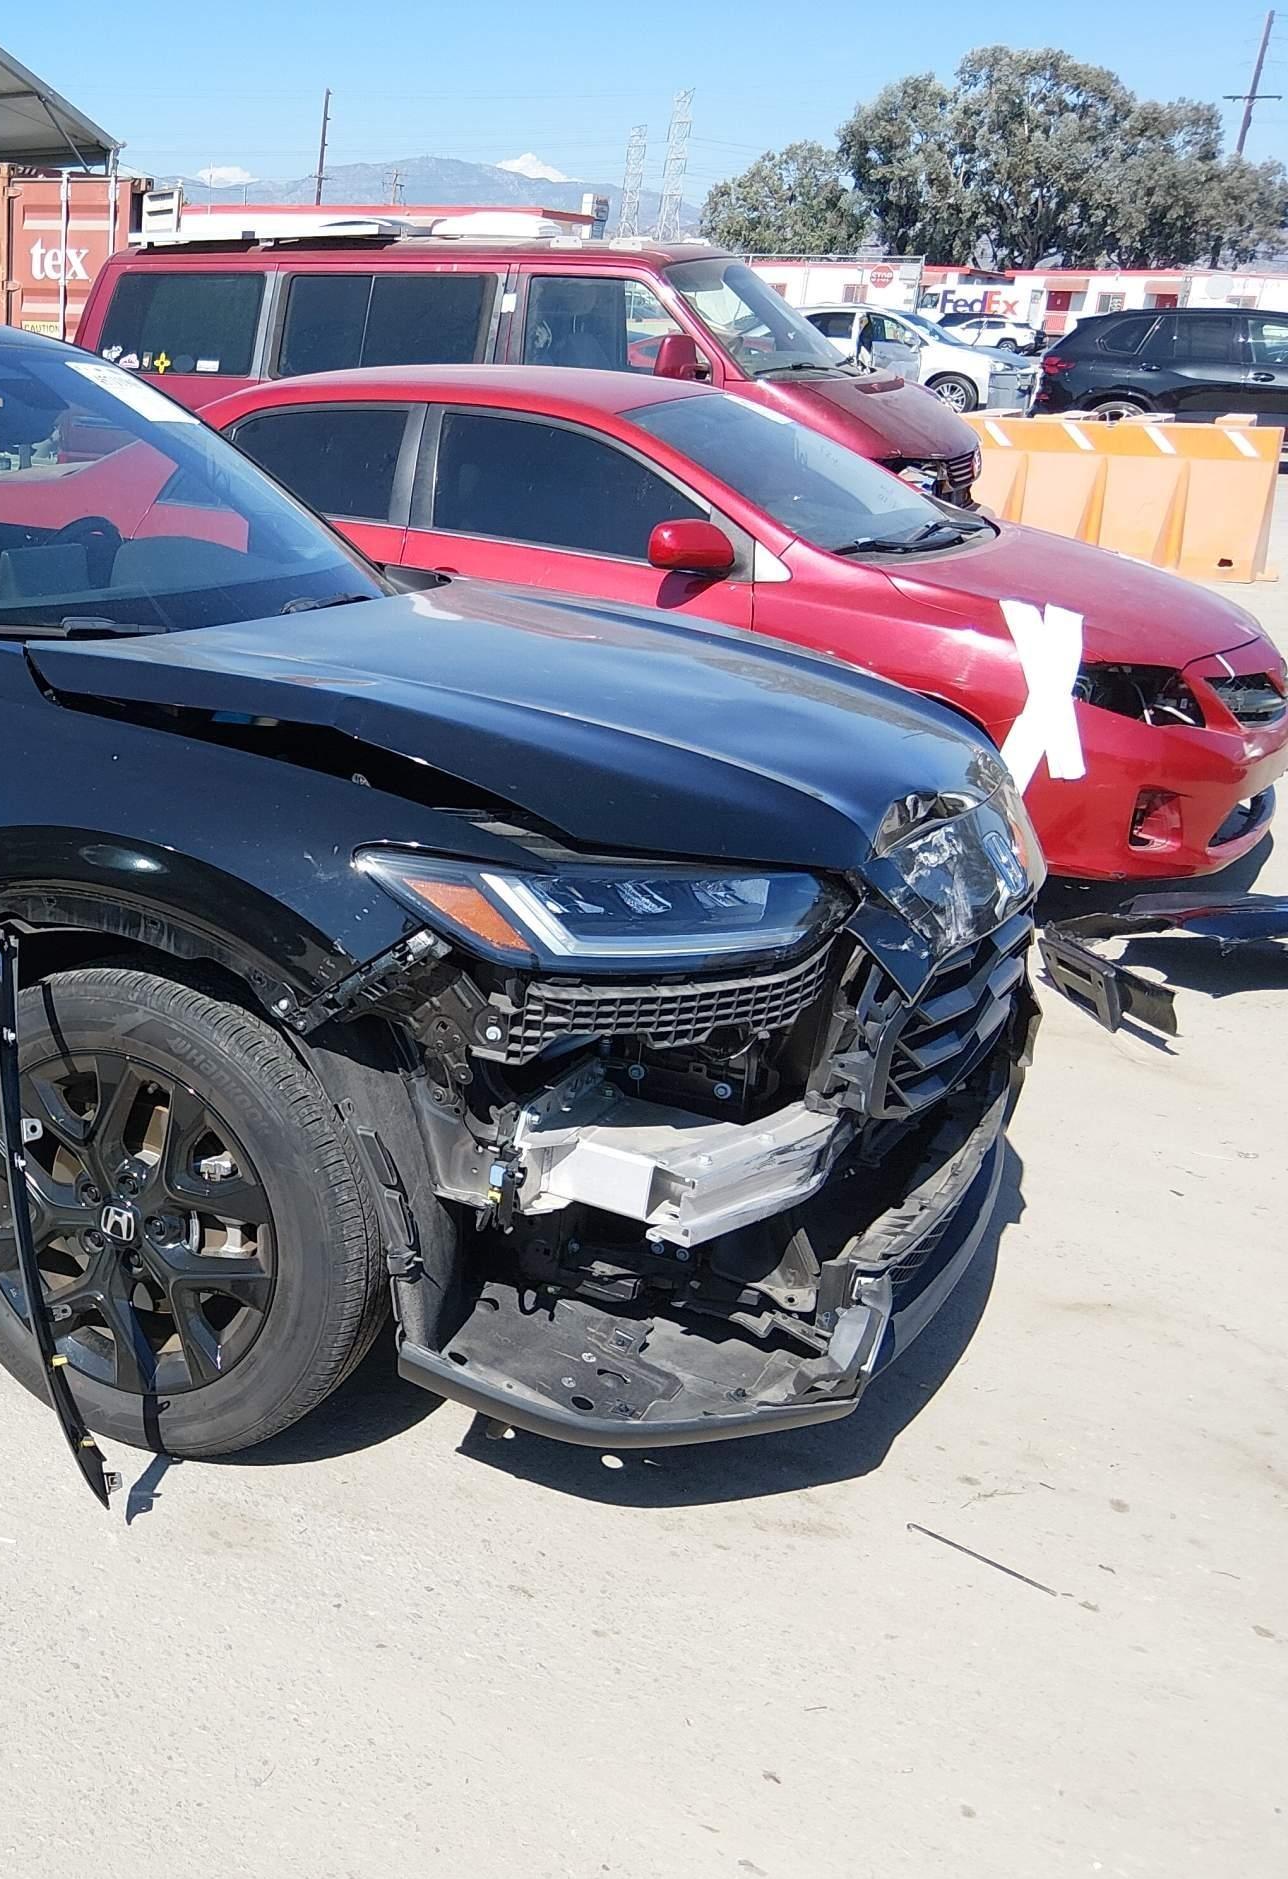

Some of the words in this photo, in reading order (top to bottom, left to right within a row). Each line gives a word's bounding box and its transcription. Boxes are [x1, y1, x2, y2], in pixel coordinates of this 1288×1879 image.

[870, 271, 893, 282] STOP
[940, 289, 1019, 315] FedEx
[24, 324, 60, 334] CAUTION
